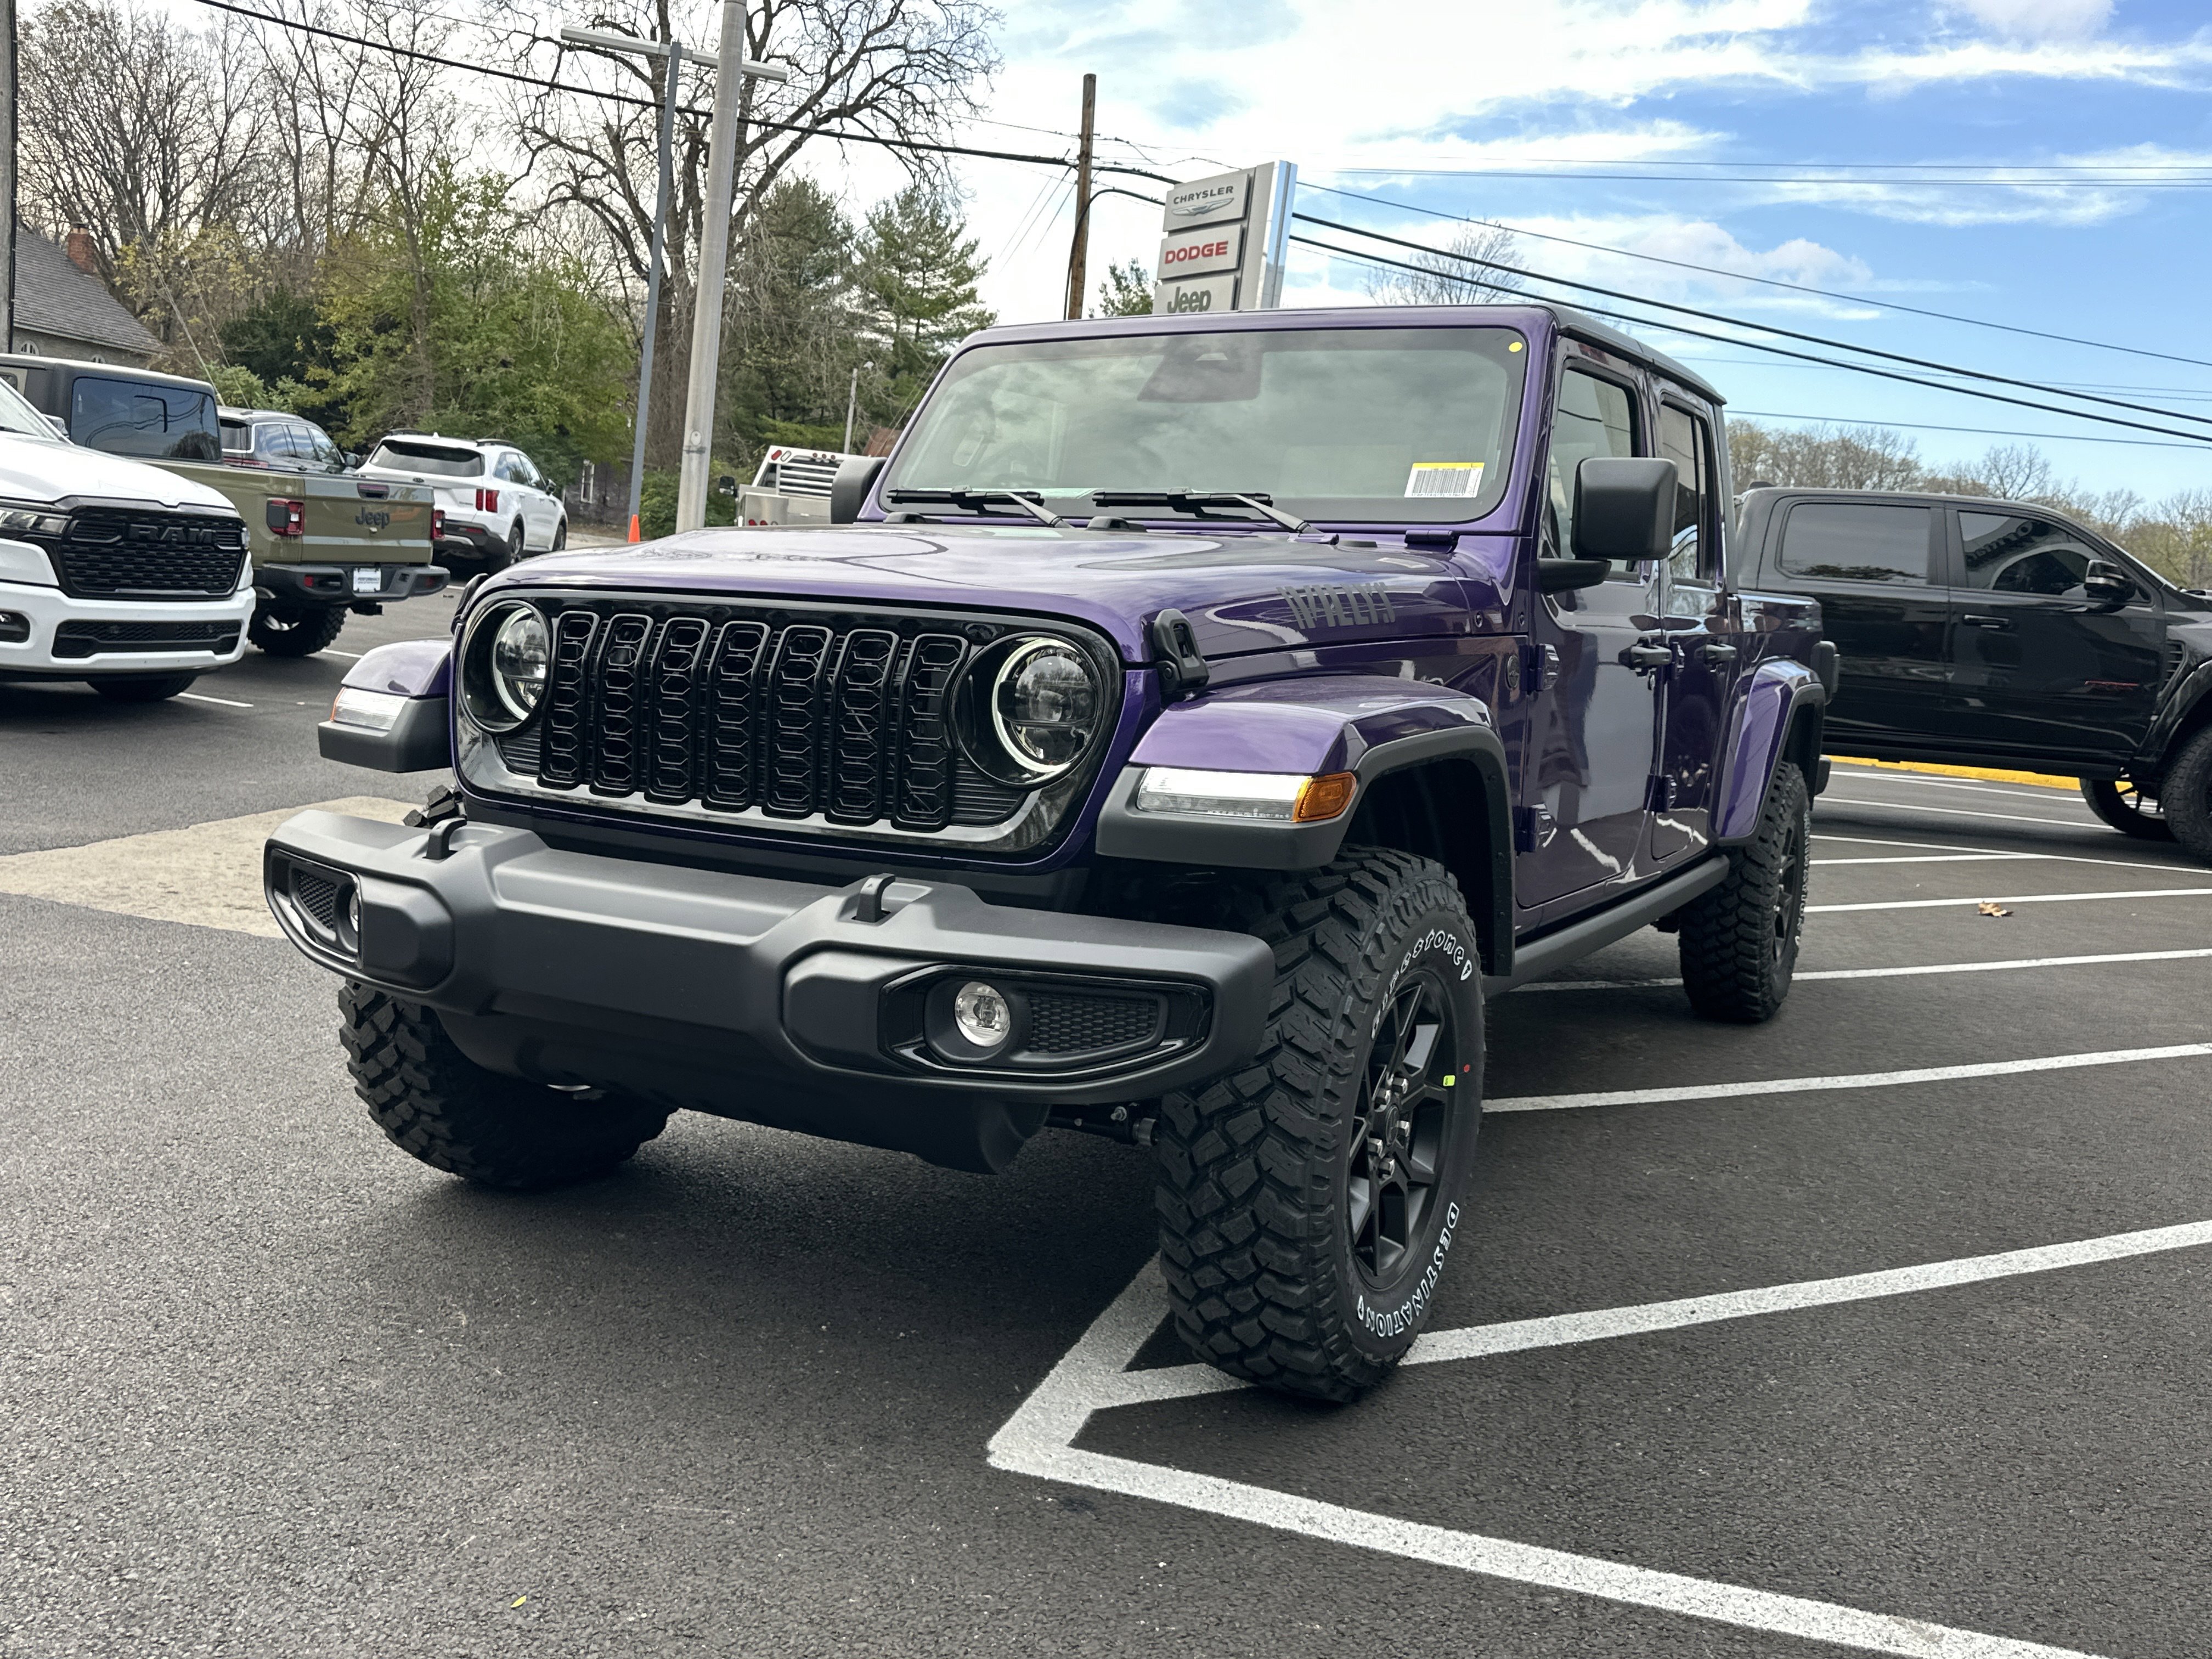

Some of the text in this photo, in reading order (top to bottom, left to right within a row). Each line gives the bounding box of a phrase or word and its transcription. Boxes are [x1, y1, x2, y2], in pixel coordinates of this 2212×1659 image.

[1173, 185, 1234, 205] CHRYSLER
[1165, 241, 1229, 264] DODGE
[1167, 286, 1211, 314] Jeep
[356, 506, 390, 529] Jeep
[129, 524, 214, 544] RAM
[1365, 1202, 1459, 1337] DESTINATION
